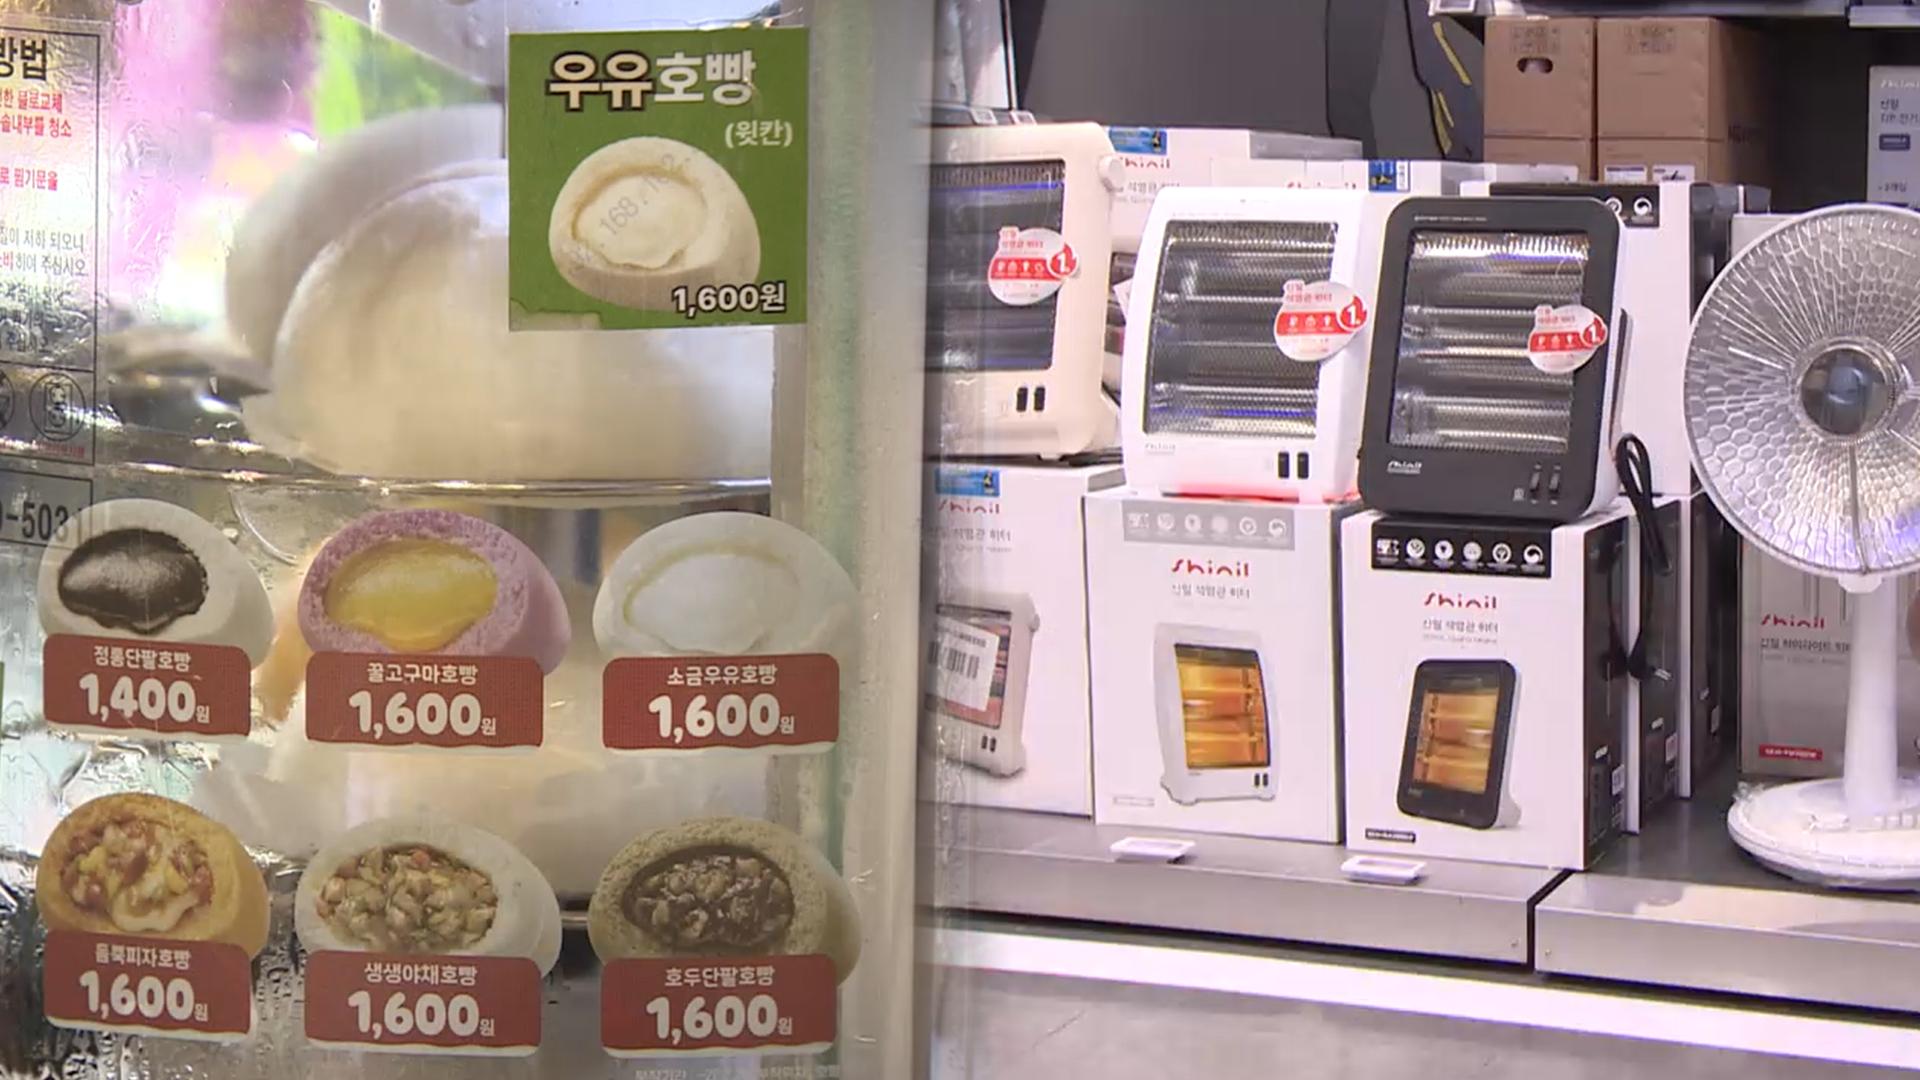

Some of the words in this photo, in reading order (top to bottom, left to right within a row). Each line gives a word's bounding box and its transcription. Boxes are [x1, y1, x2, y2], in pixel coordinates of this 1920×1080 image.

[546, 50, 756, 112] 우유호빵
[50, 117, 72, 138] 청소
[724, 119, 793, 148] (윗칸)
[672, 280, 787, 318] 1,600원
[93, 645, 192, 673] 정통단팥호빵
[367, 662, 479, 686] 꿀고구마호빵
[667, 664, 779, 687] 소금우유호빵
[78, 672, 211, 724] 1,400원
[348, 690, 498, 740] 1,600원
[647, 692, 796, 745] 1,600원
[364, 962, 479, 987] 생생야채호빵
[665, 966, 777, 988] 호두단팥호빵
[78, 969, 209, 1021] 1,600원
[347, 990, 496, 1040] 1,600원
[645, 993, 793, 1046] 1,600원
